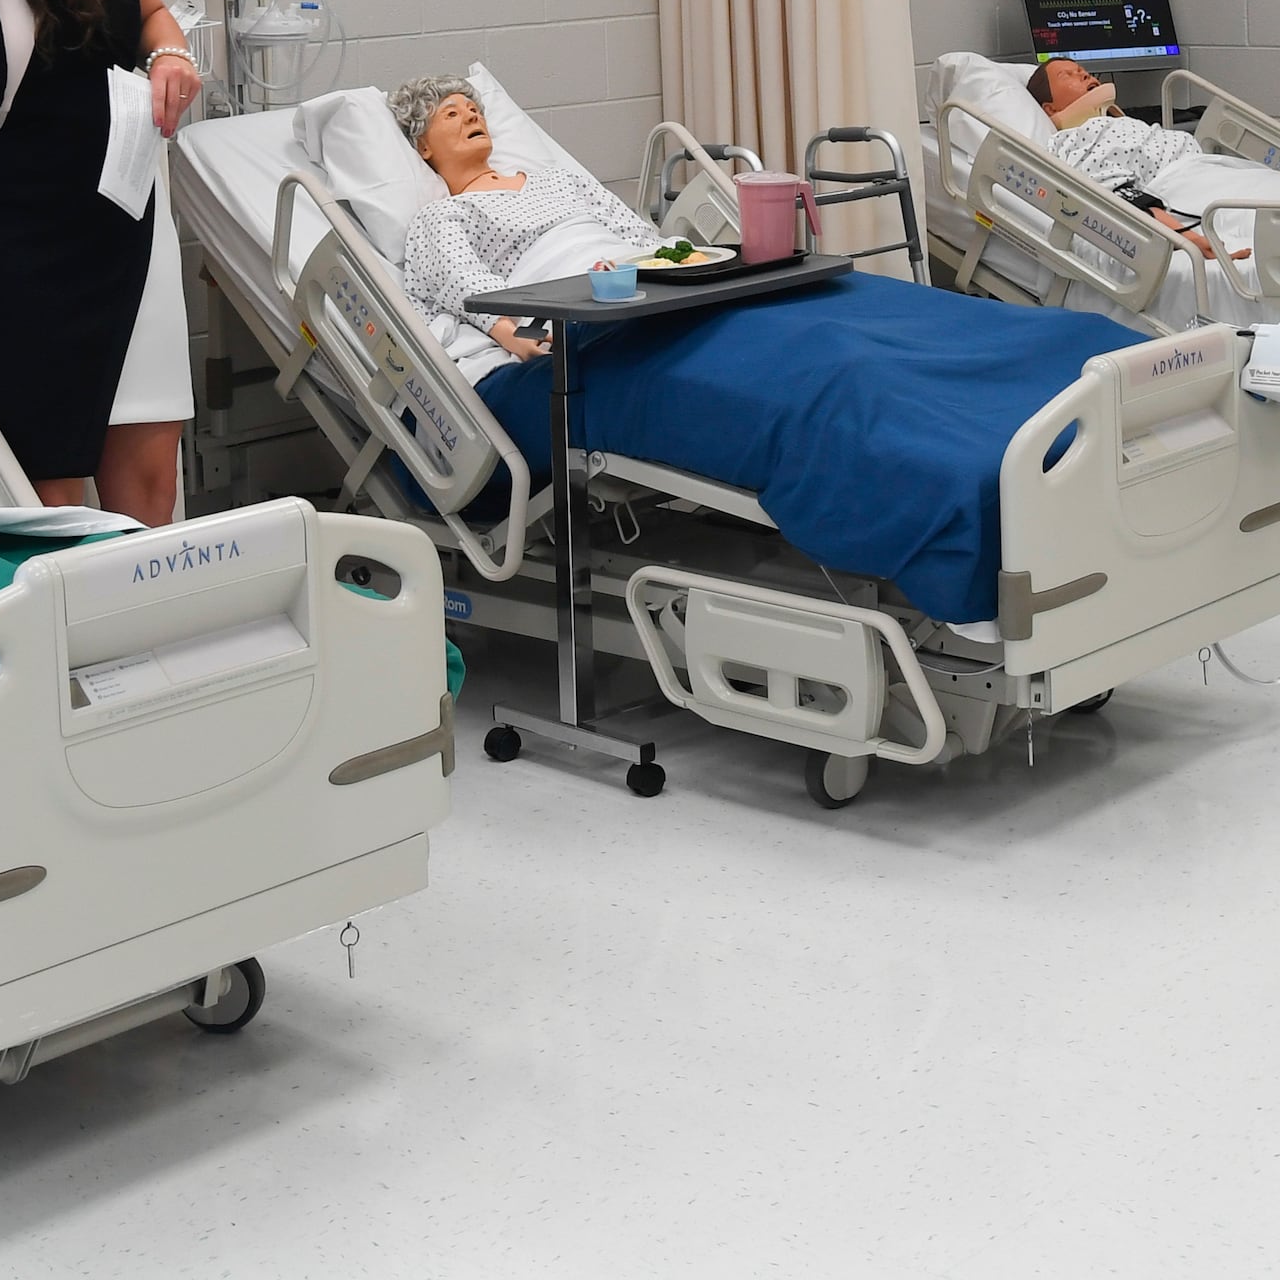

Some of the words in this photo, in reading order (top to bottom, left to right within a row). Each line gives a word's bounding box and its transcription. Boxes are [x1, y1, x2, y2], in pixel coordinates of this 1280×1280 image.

[1081, 215, 1137, 256] ADVANTA
[1152, 348, 1203, 376] ADVANTA
[405, 378, 457, 449] ADVANTA
[132, 540, 240, 583] ADVANTA
